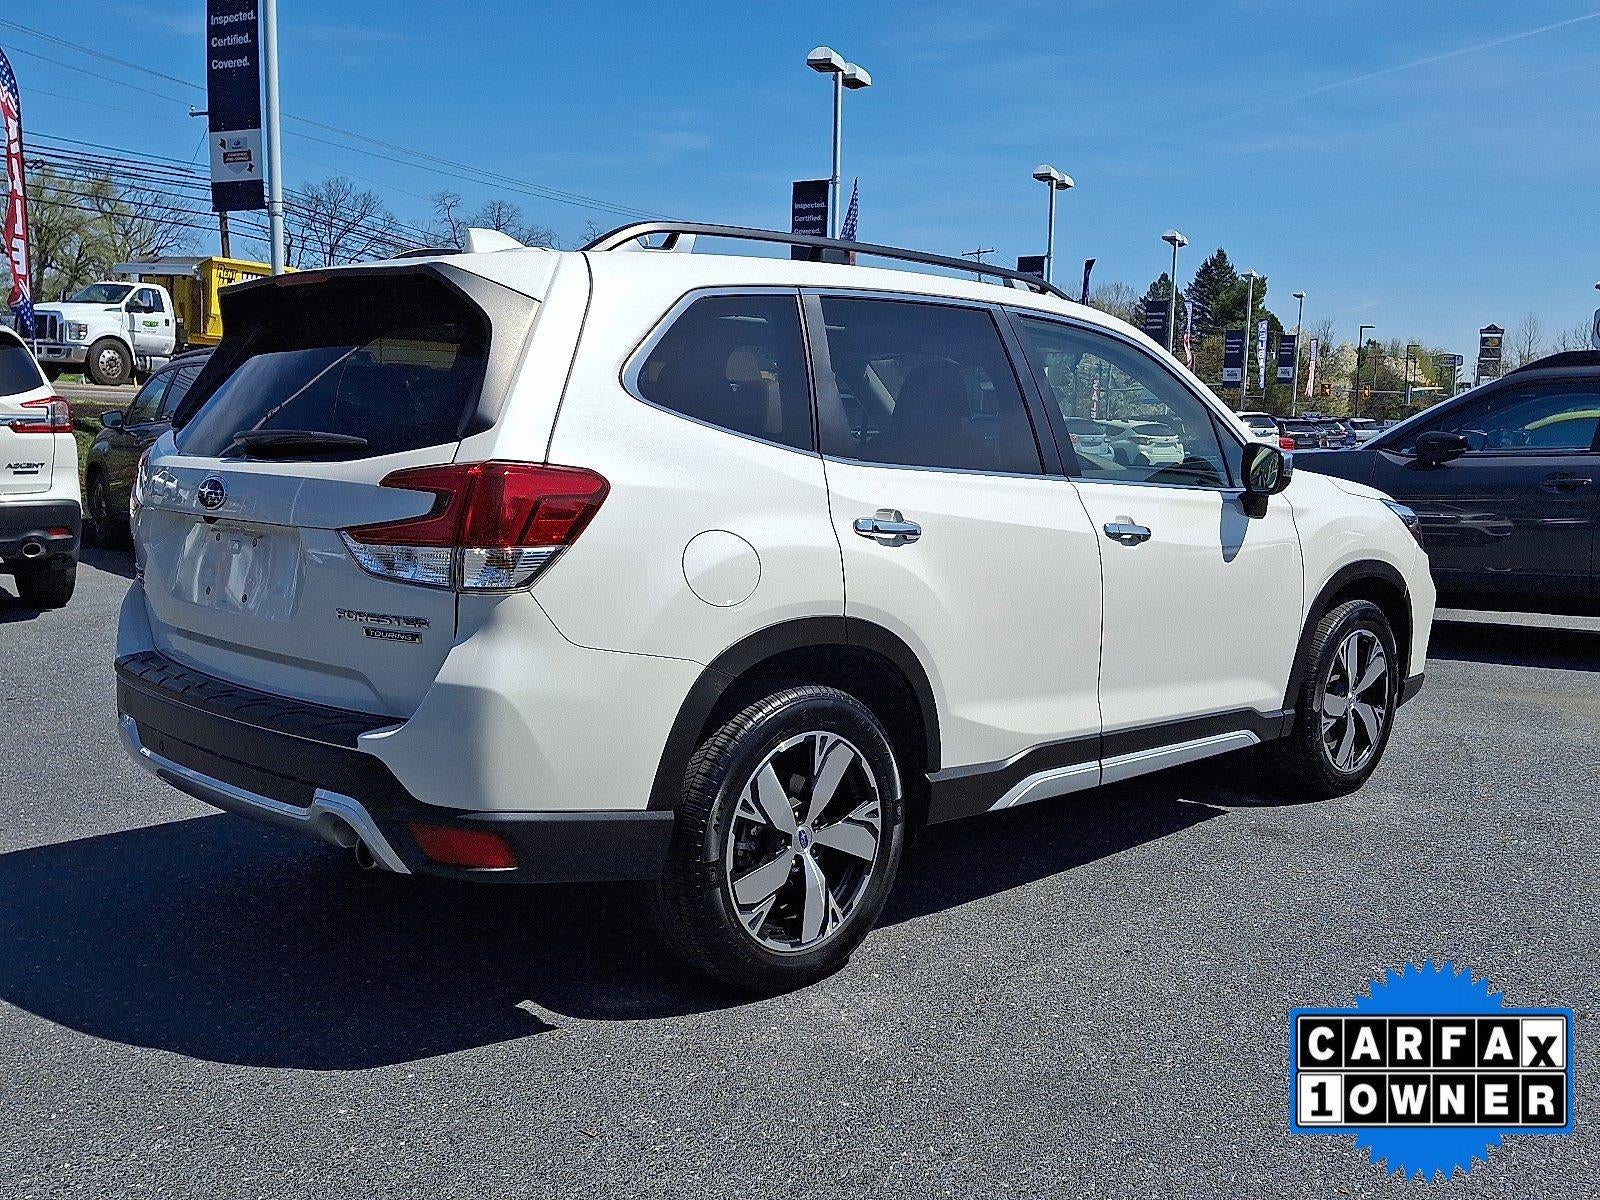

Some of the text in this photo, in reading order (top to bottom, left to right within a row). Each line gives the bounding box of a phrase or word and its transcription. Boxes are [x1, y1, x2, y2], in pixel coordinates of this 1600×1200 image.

[211, 10, 256, 26] Inspected.
[211, 33, 252, 48] Certified.
[211, 56, 250, 70] Covered.
[794, 201, 827, 210] Inspected.
[5, 462, 46, 470] ASCENT
[335, 607, 430, 629] FORESTER
[368, 629, 412, 641] TOURING
